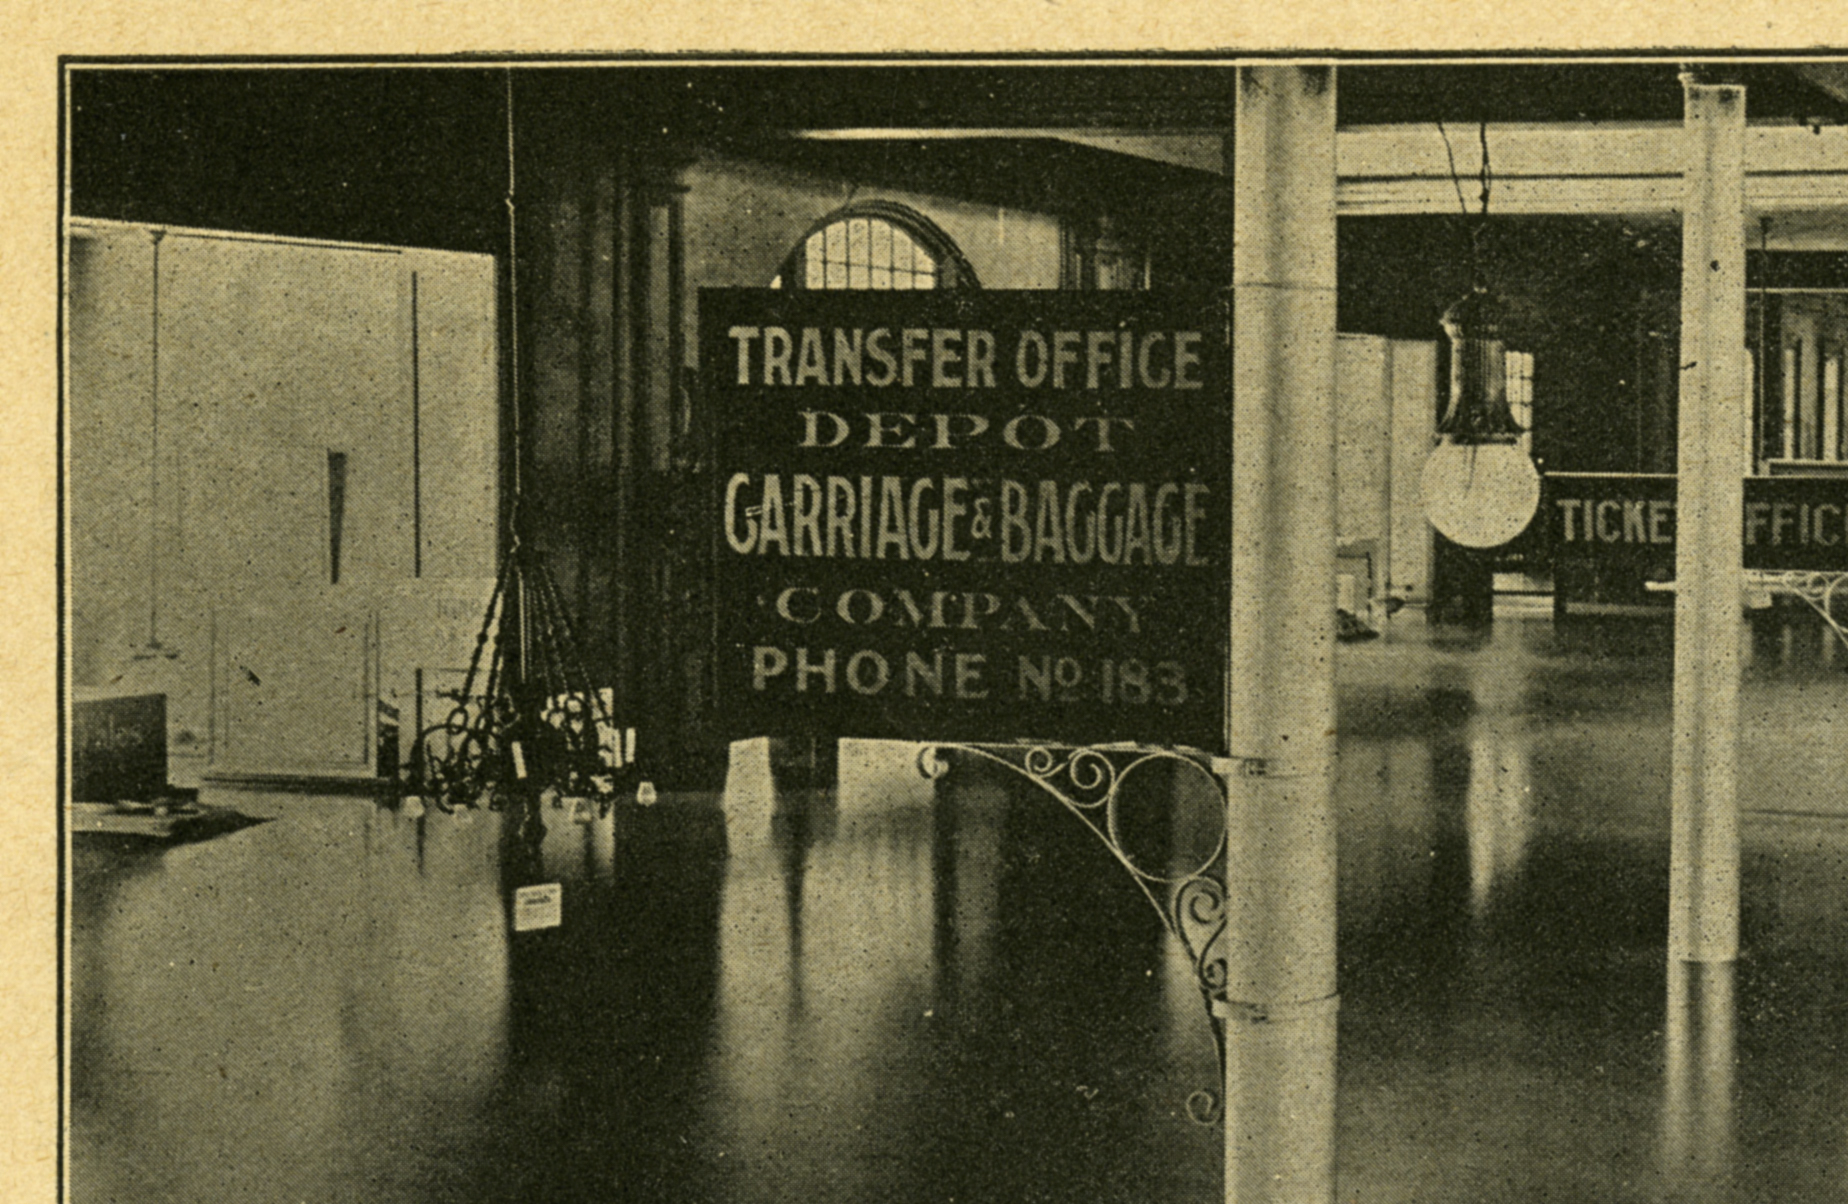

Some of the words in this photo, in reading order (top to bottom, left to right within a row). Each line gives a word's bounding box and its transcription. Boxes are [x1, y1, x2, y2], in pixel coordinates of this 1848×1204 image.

[727, 325, 996, 388] TRANSFER
[1014, 329, 1203, 390] OFFICE
[799, 409, 1135, 452] DEPOT
[970, 496, 992, 540] &
[1000, 478, 1211, 566] BAGGAGE
[1556, 498, 1674, 543] TICKE
[774, 586, 1152, 633] COMPANY
[752, 645, 989, 698] PHONE
[1101, 657, 1190, 704] 183
